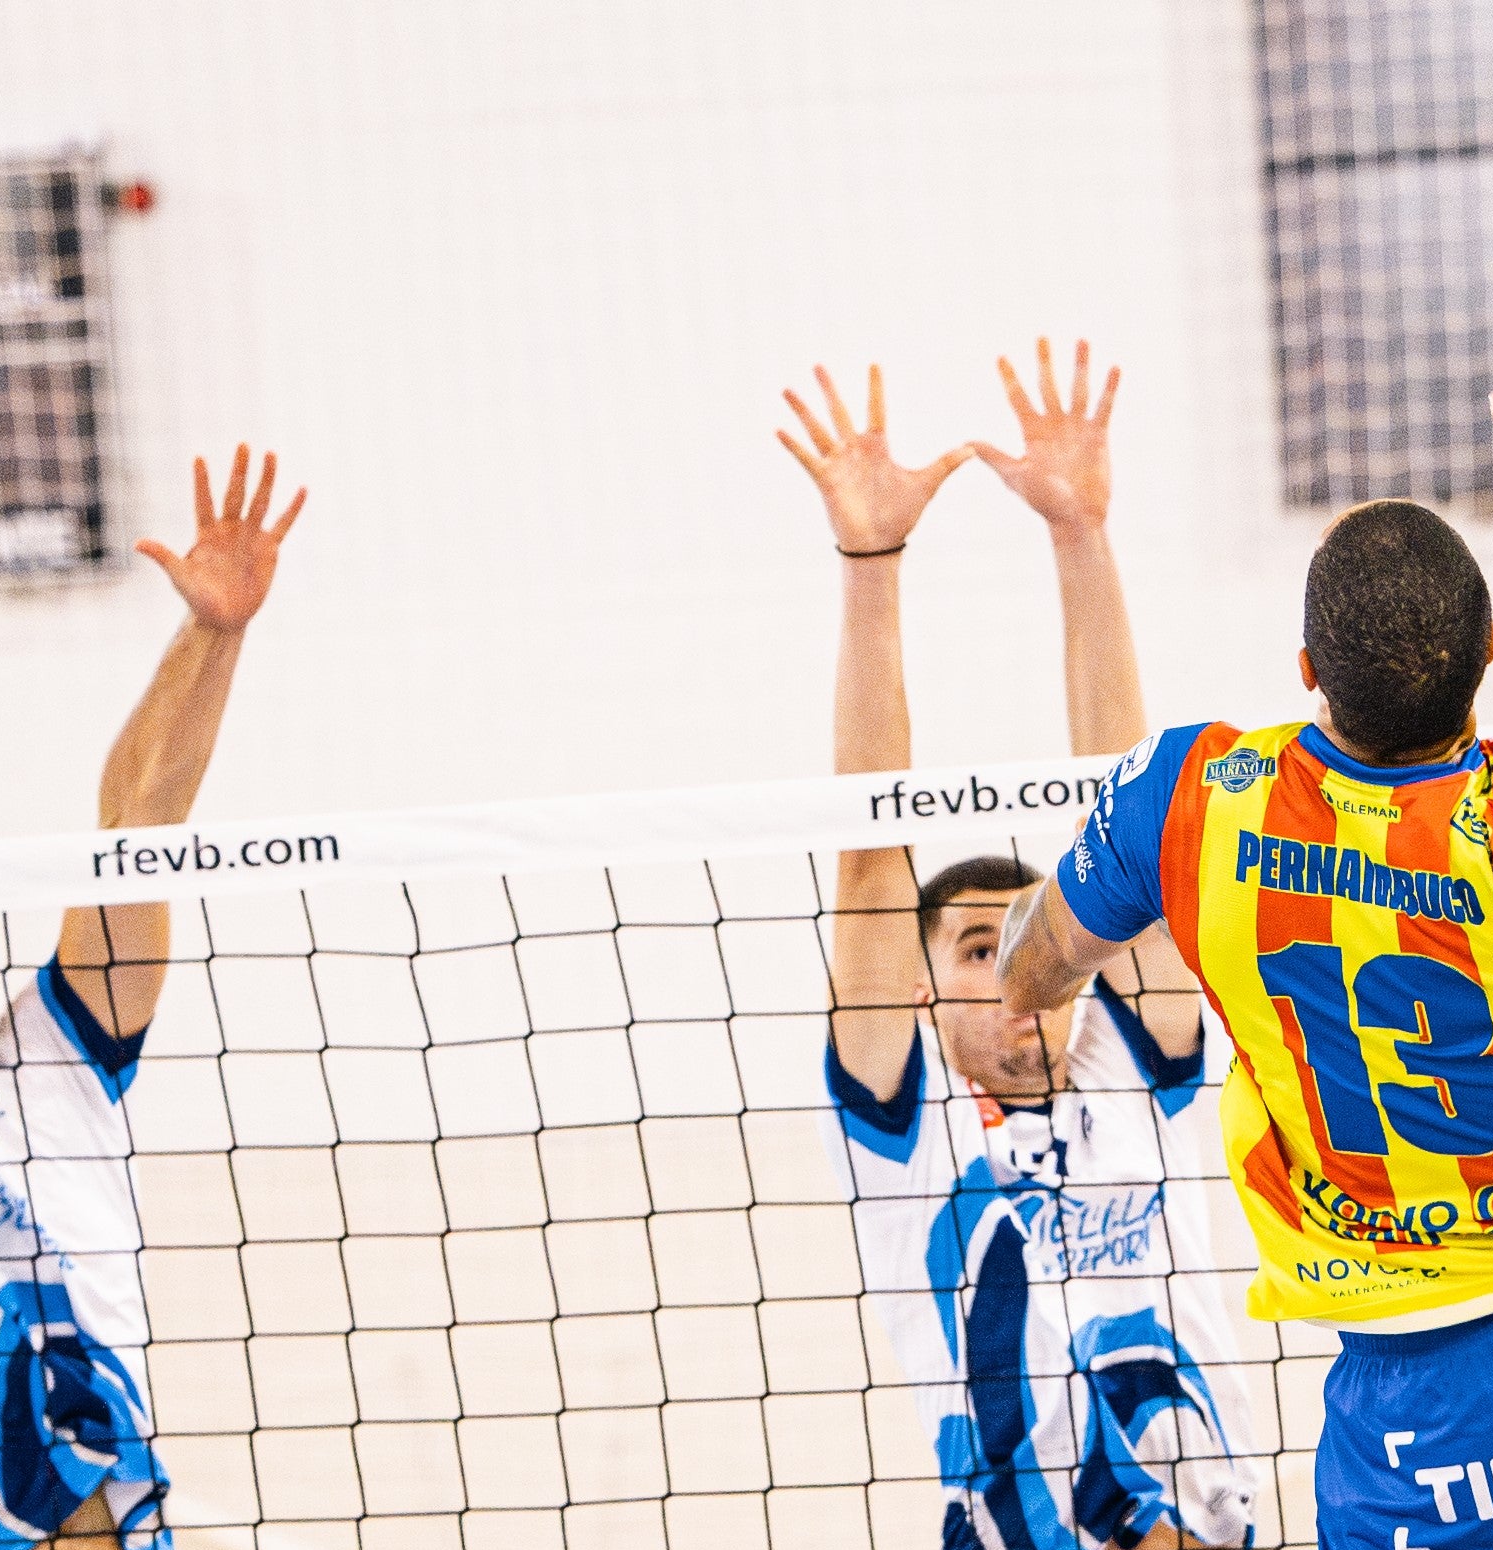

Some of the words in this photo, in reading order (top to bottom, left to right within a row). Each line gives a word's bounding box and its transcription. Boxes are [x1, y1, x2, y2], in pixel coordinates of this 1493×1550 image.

[870, 775, 1106, 821] rfevb.com
[1336, 800, 1399, 819] LÉLEMAN
[93, 832, 341, 879] rfevb.com
[1236, 829, 1486, 926] PERNAMBUCO
